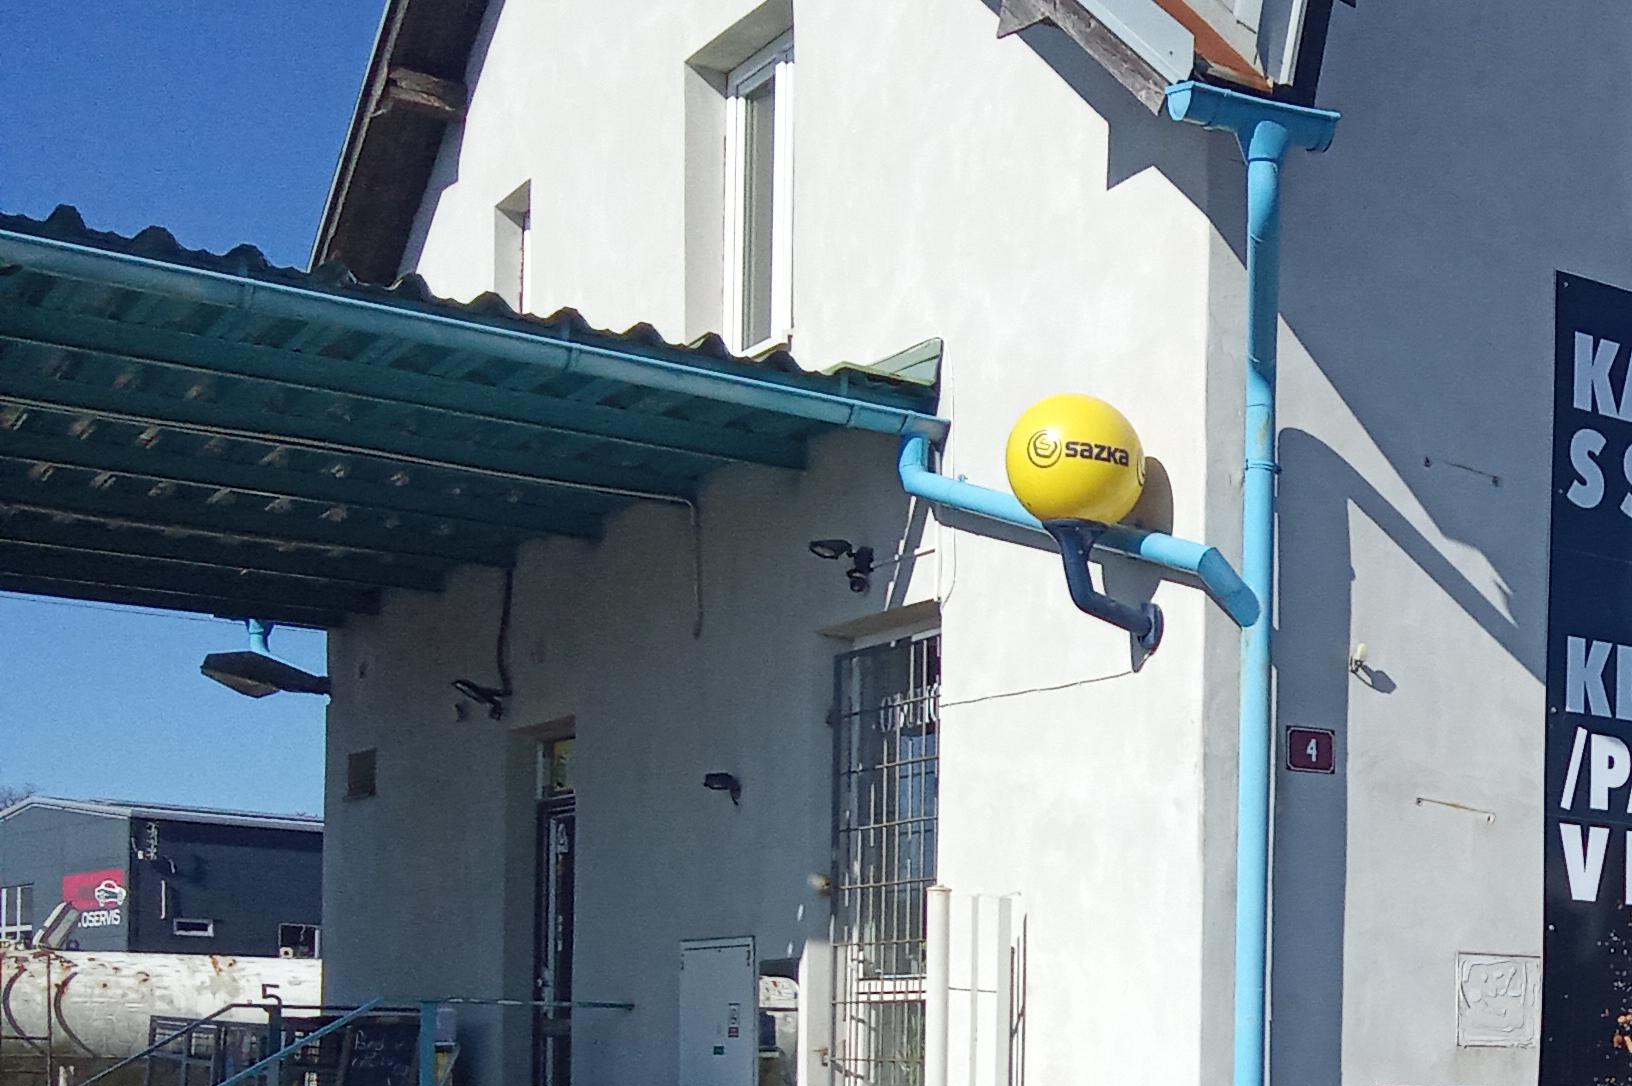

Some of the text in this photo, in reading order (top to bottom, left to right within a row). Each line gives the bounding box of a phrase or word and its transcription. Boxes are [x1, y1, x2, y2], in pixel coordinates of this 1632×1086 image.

[1566, 428, 1607, 509] S
[1306, 738, 1317, 762] 4
[1559, 822, 1610, 902] V
[78, 908, 121, 928] OSERVIS
